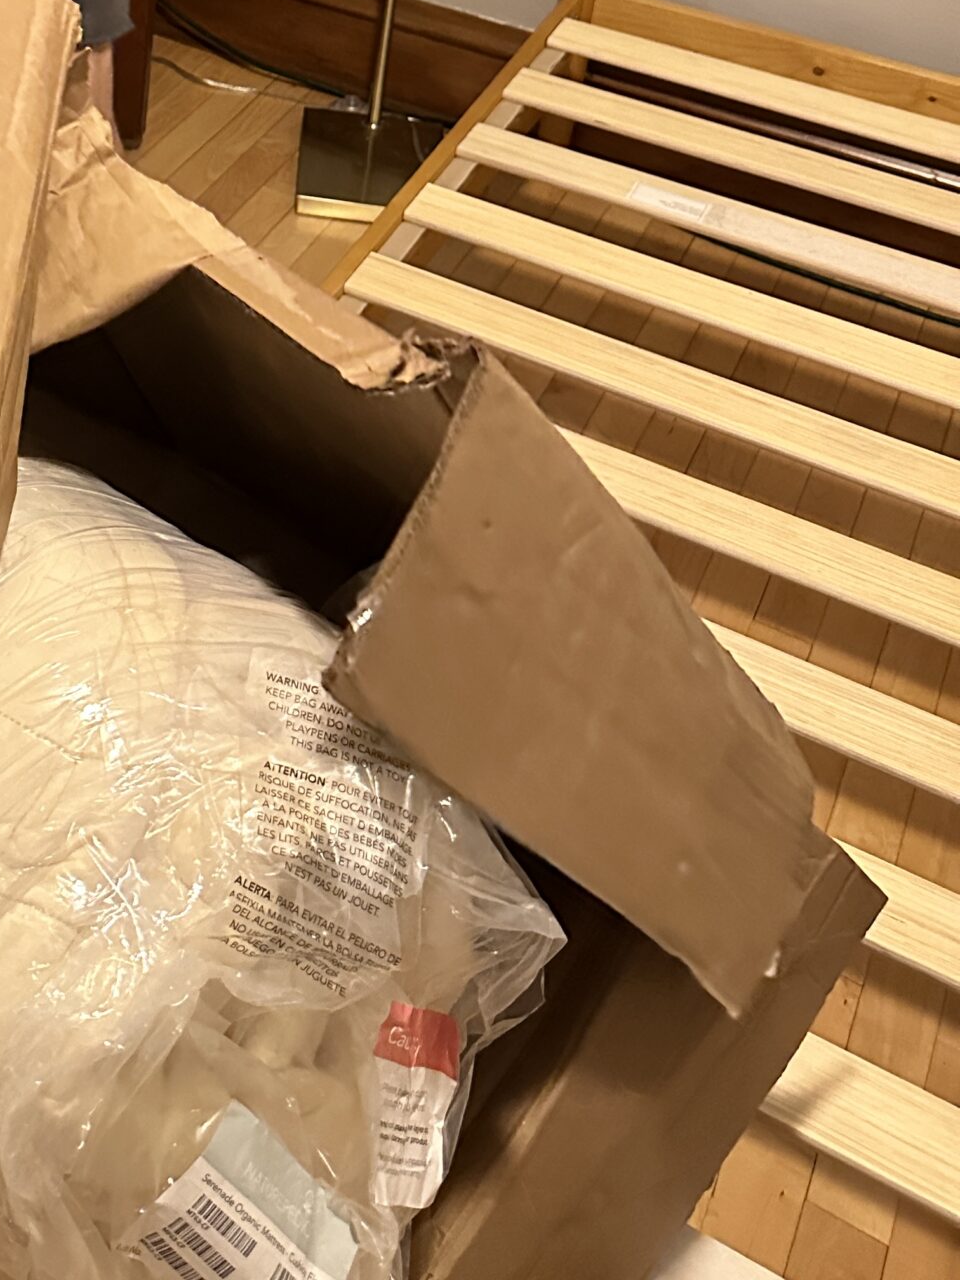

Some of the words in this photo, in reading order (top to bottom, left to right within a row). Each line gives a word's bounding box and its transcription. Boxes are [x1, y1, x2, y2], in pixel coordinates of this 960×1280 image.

[265, 686, 292, 700] KEEP
[294, 694, 317, 709] BAG
[286, 720, 338, 744] PLAYPENS
[340, 736, 355, 750] OR
[326, 717, 344, 731] DO
[345, 724, 368, 740] NOT
[291, 735, 313, 751] THIS
[315, 743, 338, 758] BAG
[340, 750, 350, 762] IS
[352, 755, 374, 771] NOT
[376, 765, 384, 775] A
[254, 783, 296, 805] LAISSER
[297, 799, 312, 813] CE
[313, 805, 356, 827] SACHET
[258, 771, 295, 792] RISQUE
[297, 786, 313, 799] DE
[392, 819, 406, 834] NE
[272, 802, 287, 814] LA
[329, 825, 350, 841] DES
[331, 780, 361, 798] POUR
[398, 806, 419, 825] TOUT
[257, 825, 276, 840] LES
[305, 840, 337, 863] PARCS
[338, 856, 352, 869] ET
[309, 831, 325, 845] NE
[327, 838, 347, 852] PAS
[349, 845, 391, 871] UTILISER
[271, 845, 287, 857] CE
[289, 849, 330, 873] SACHET
[330, 867, 395, 908] D'EMBALLAGE
[284, 860, 313, 883] N'EST
[313, 876, 332, 893] PAS
[332, 885, 348, 900] UN
[231, 903, 251, 921] DEL
[275, 895, 300, 917] PARA
[300, 908, 335, 934] EVITAR
[335, 927, 346, 940] EL
[347, 932, 387, 959] PELIGRO
[386, 953, 403, 967] DE
[228, 919, 247, 934] NO
[269, 936, 286, 949] EN
[322, 936, 334, 951] LA
[300, 964, 347, 999] JUGUETE
[202, 1173, 235, 1207] Serenade
[234, 1202, 261, 1231] Organic
